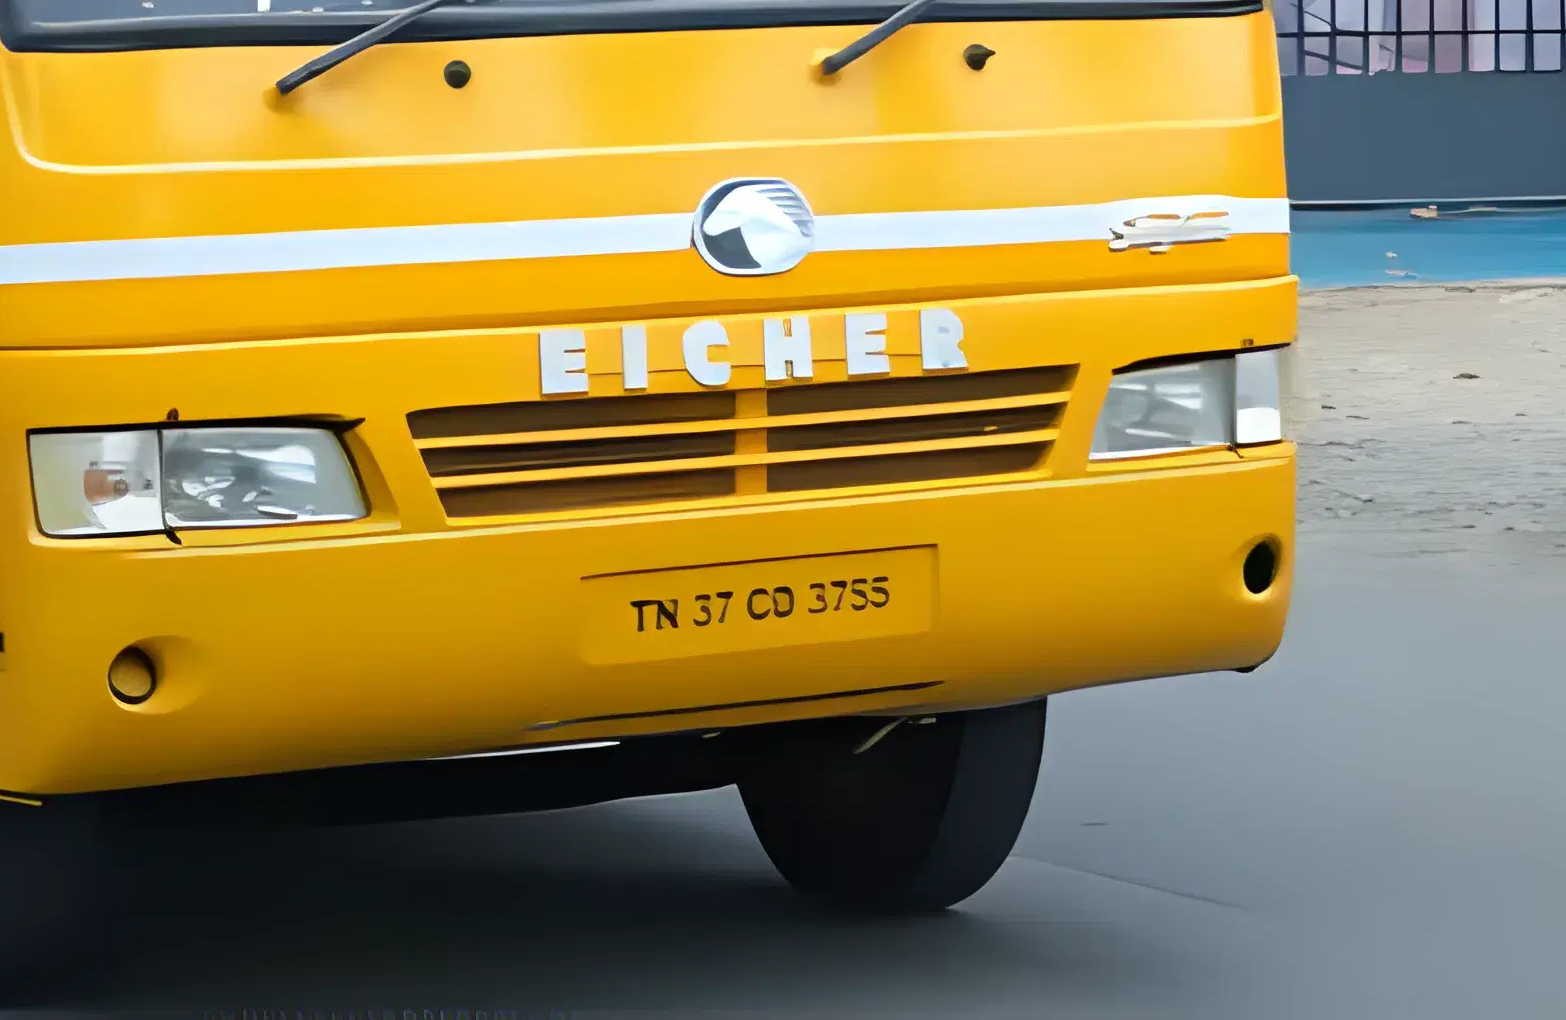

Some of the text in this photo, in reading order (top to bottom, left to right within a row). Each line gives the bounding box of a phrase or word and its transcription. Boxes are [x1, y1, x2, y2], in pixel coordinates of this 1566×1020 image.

[537, 307, 969, 396] EICHER
[629, 598, 680, 633] TN
[691, 591, 735, 628] 37
[806, 575, 891, 615] 3755
